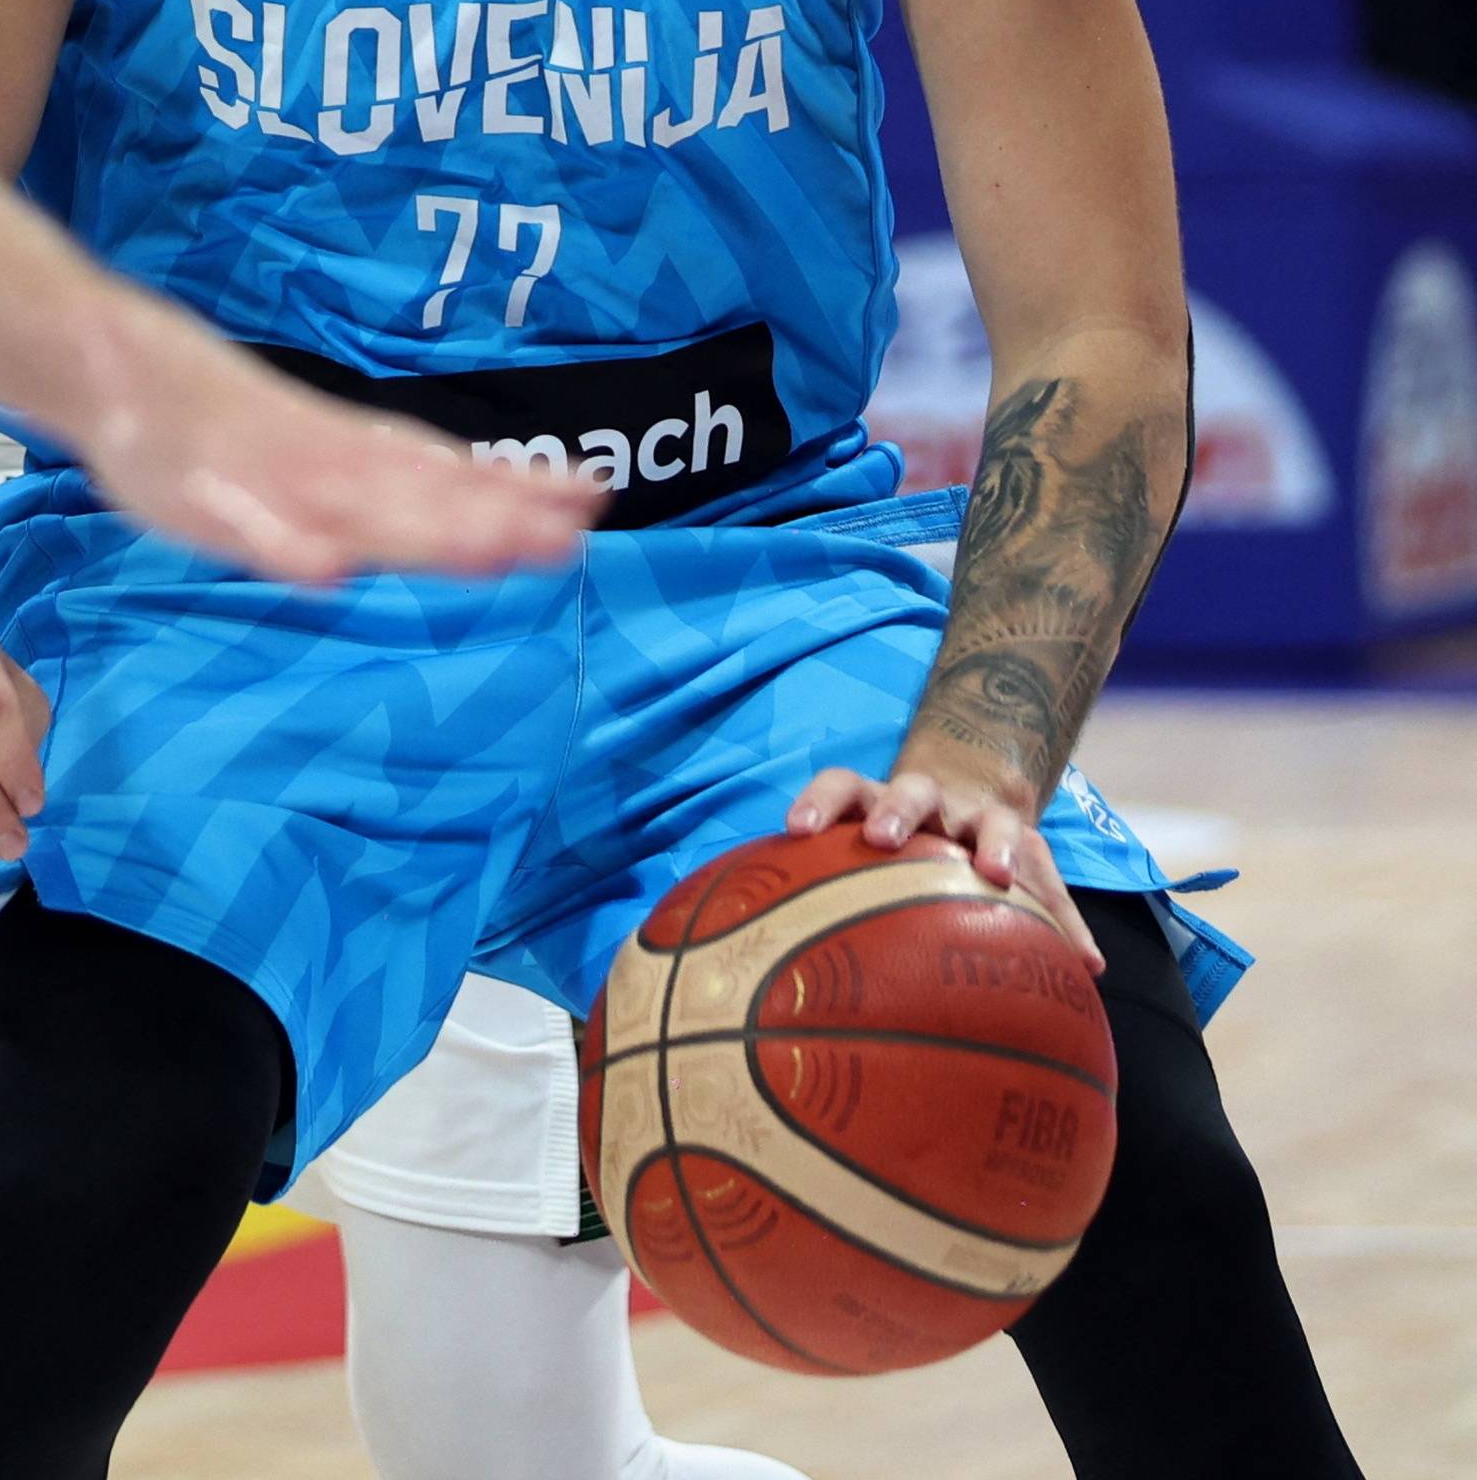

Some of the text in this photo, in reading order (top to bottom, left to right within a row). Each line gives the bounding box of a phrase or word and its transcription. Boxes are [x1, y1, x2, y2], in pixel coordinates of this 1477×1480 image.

[416, 195, 561, 328] 77
[425, 389, 744, 497] mach
[994, 1088, 1079, 1161] FIBA
